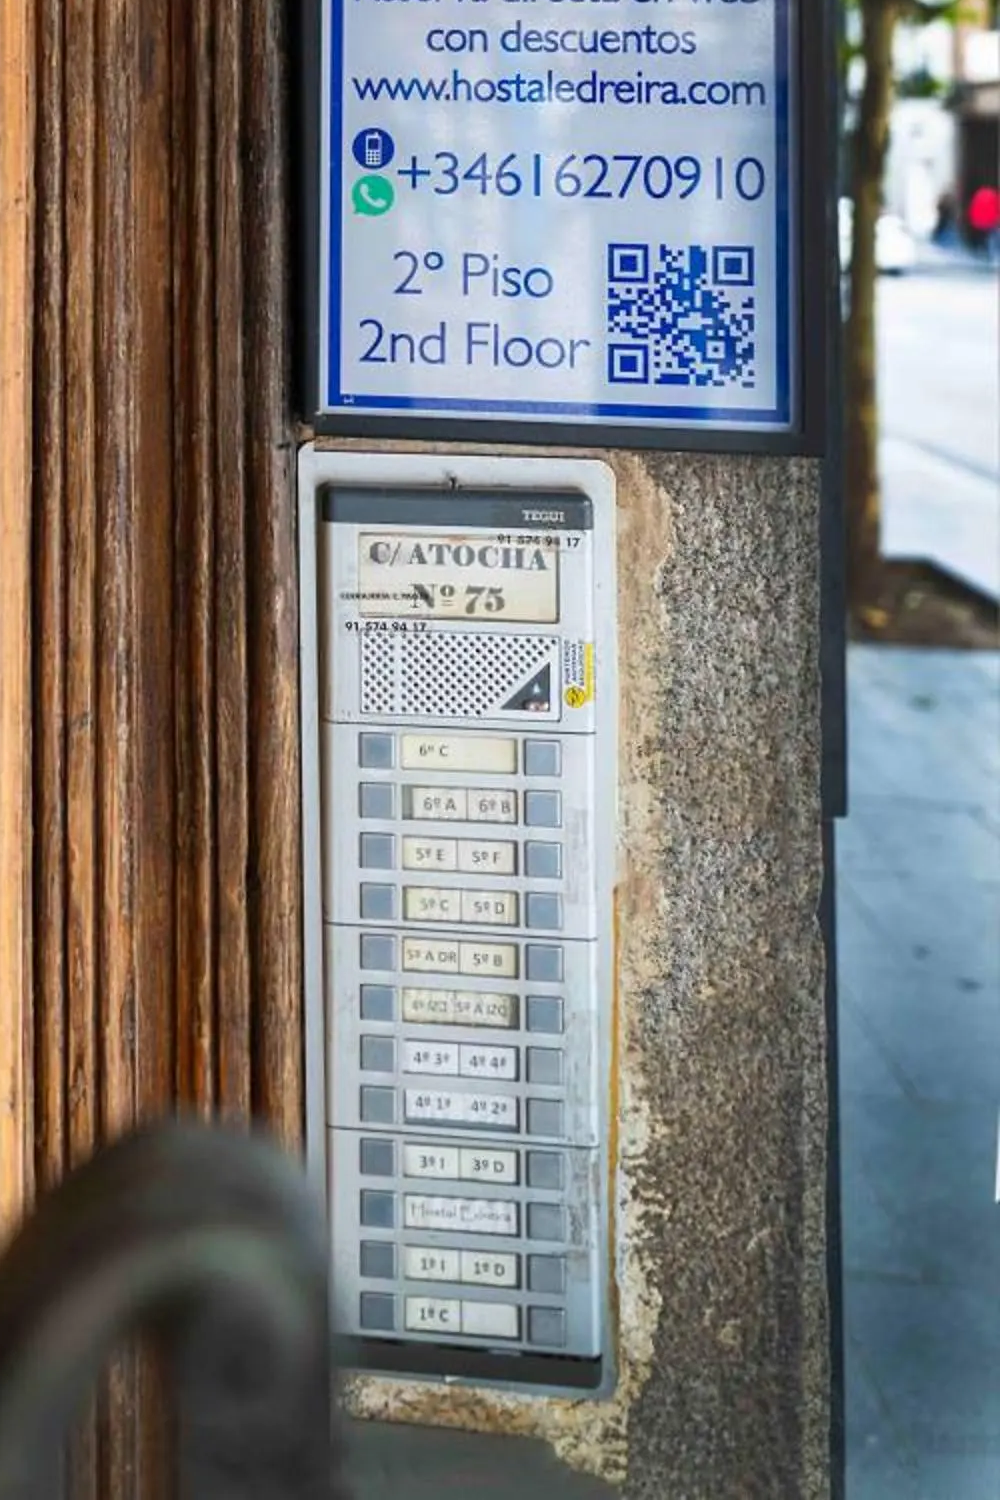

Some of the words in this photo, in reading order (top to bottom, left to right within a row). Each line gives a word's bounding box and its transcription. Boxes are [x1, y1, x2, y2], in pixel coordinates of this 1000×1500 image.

[426, 25, 488, 53] con
[500, 20, 697, 56] descuentos
[351, 69, 767, 106] www.hostaledreira.com
[397, 151, 766, 201] +34616270910
[462, 252, 555, 299] Piso
[358, 319, 447, 366] 2nd
[466, 322, 592, 369] Floor
[368, 541, 402, 568] C/
[407, 543, 547, 571] ATOCHA
[566, 536, 581, 548] 17
[463, 585, 506, 615] 75
[345, 621, 360, 633] 91
[443, 798, 457, 812] A
[435, 849, 446, 862] E
